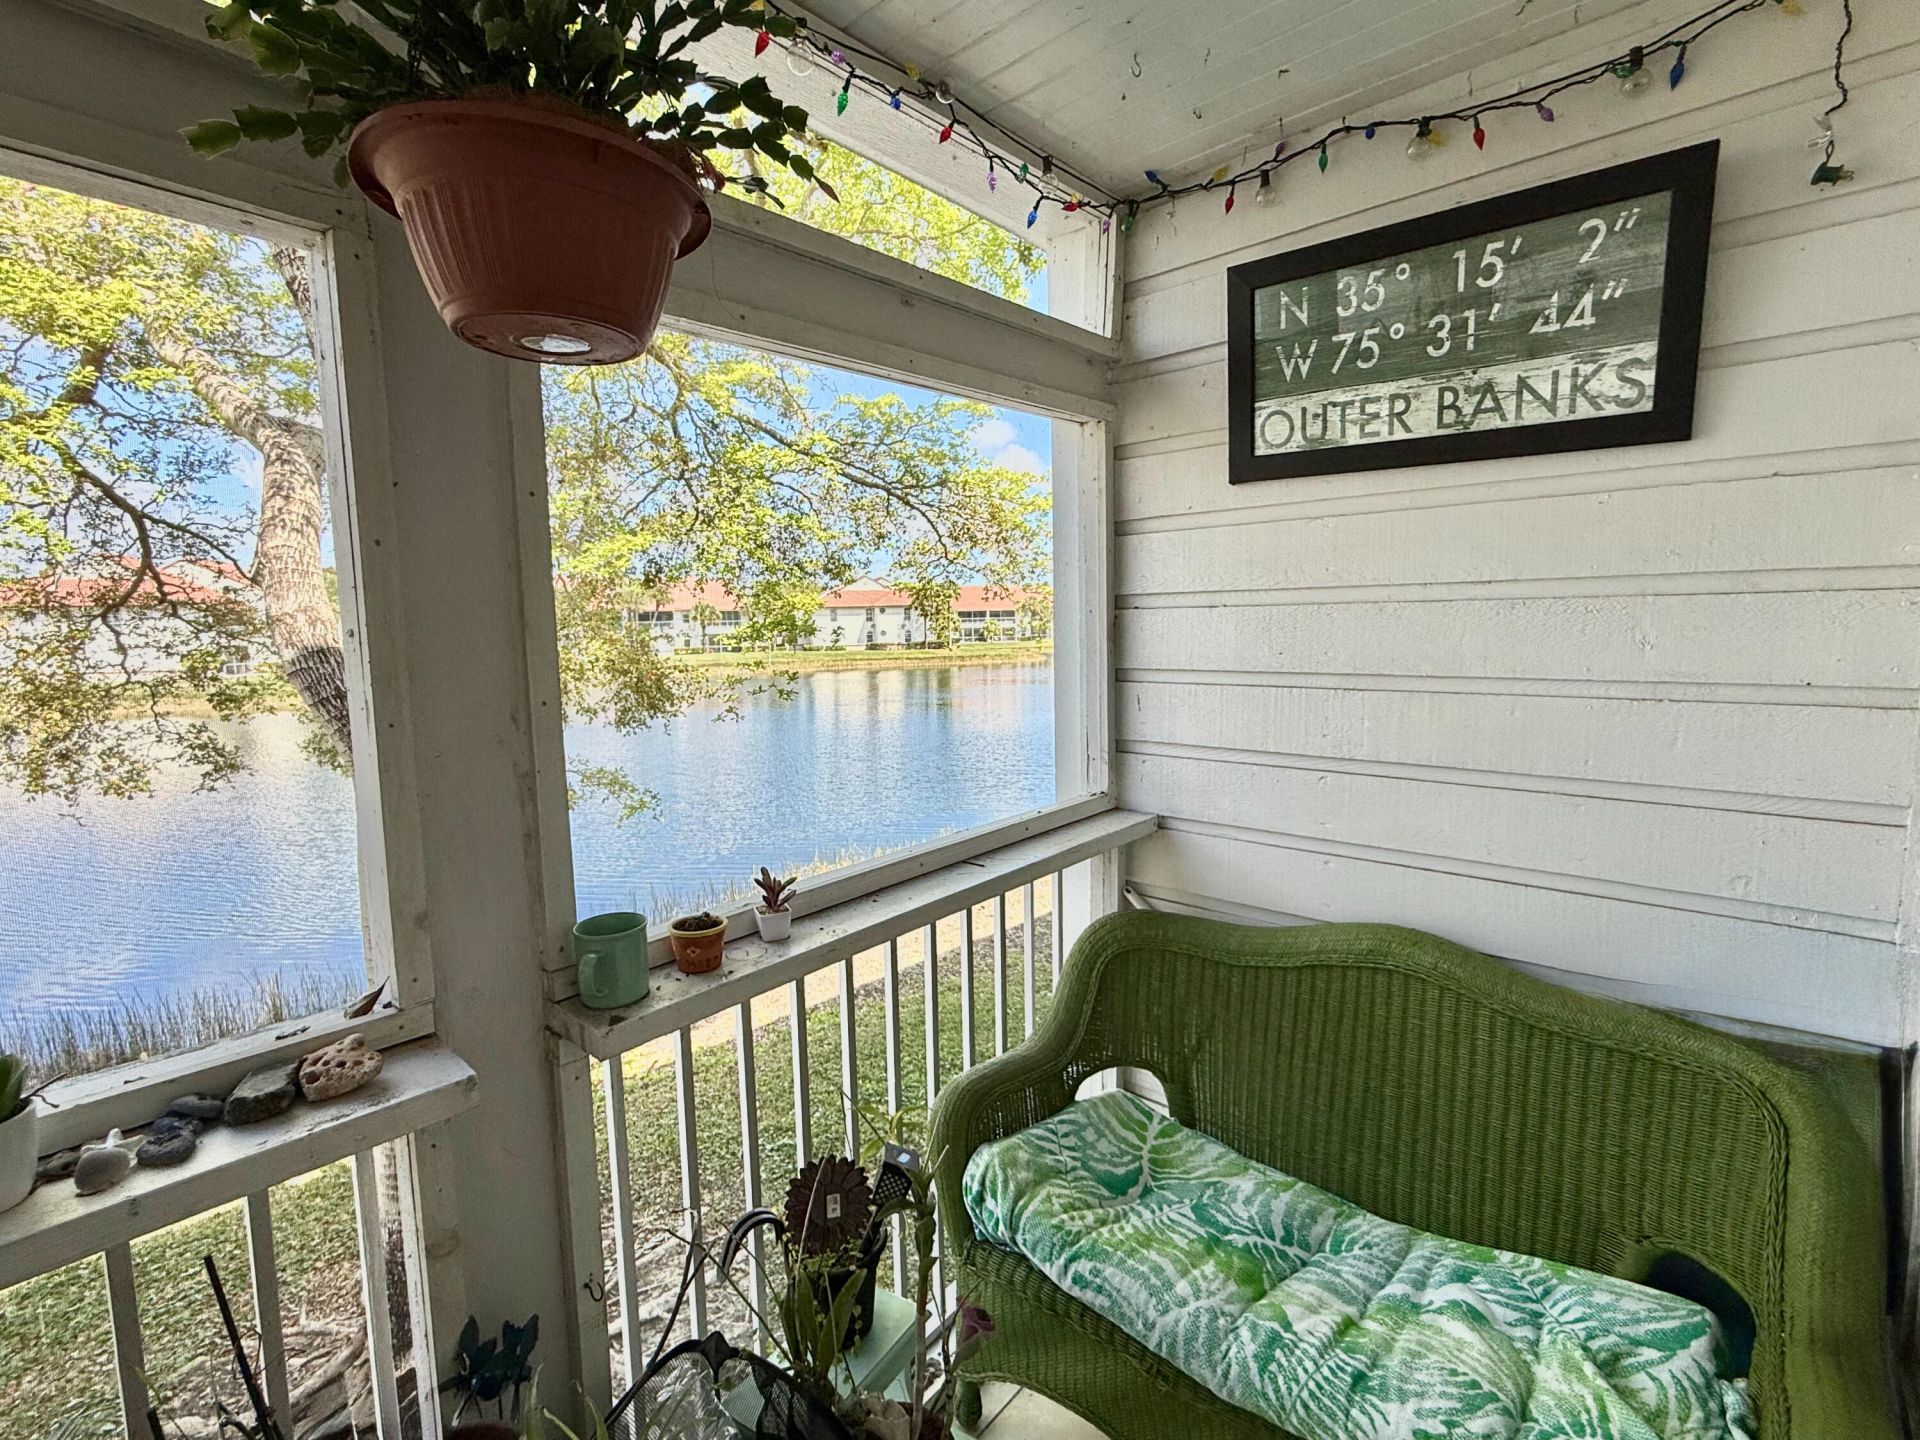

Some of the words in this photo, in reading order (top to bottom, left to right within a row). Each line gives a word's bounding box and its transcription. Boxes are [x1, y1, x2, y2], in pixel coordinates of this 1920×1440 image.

[1279, 286, 1309, 330] N
[1336, 262, 1411, 318] 35°
[1275, 338, 1319, 383] W
[1331, 322, 1405, 375] 75°
[1260, 391, 1414, 449] OUTER
[1436, 357, 1648, 431] BANKS
